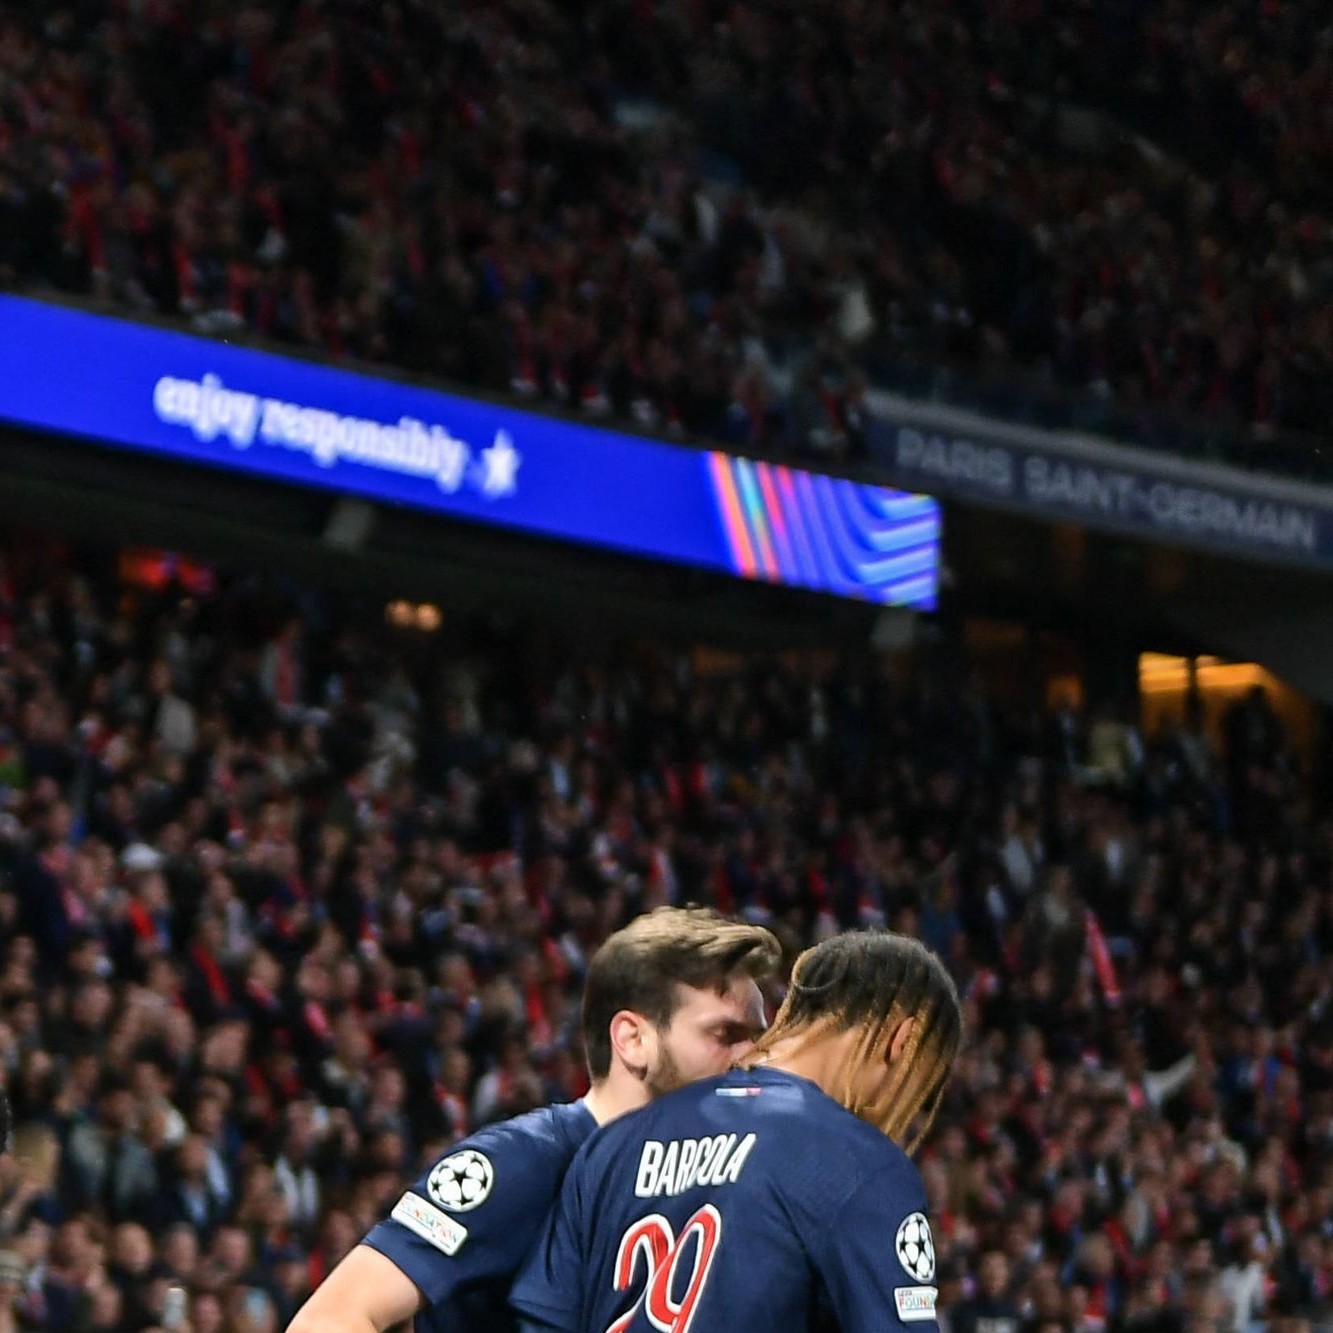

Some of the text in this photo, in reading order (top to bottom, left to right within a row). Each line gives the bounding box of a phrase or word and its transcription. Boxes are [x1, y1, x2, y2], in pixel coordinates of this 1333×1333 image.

[153, 373, 469, 494] enjoy responsibly
[896, 428, 1314, 548] PARIS SAINT-GERMAIN
[634, 1133, 757, 1198] BARCOLA
